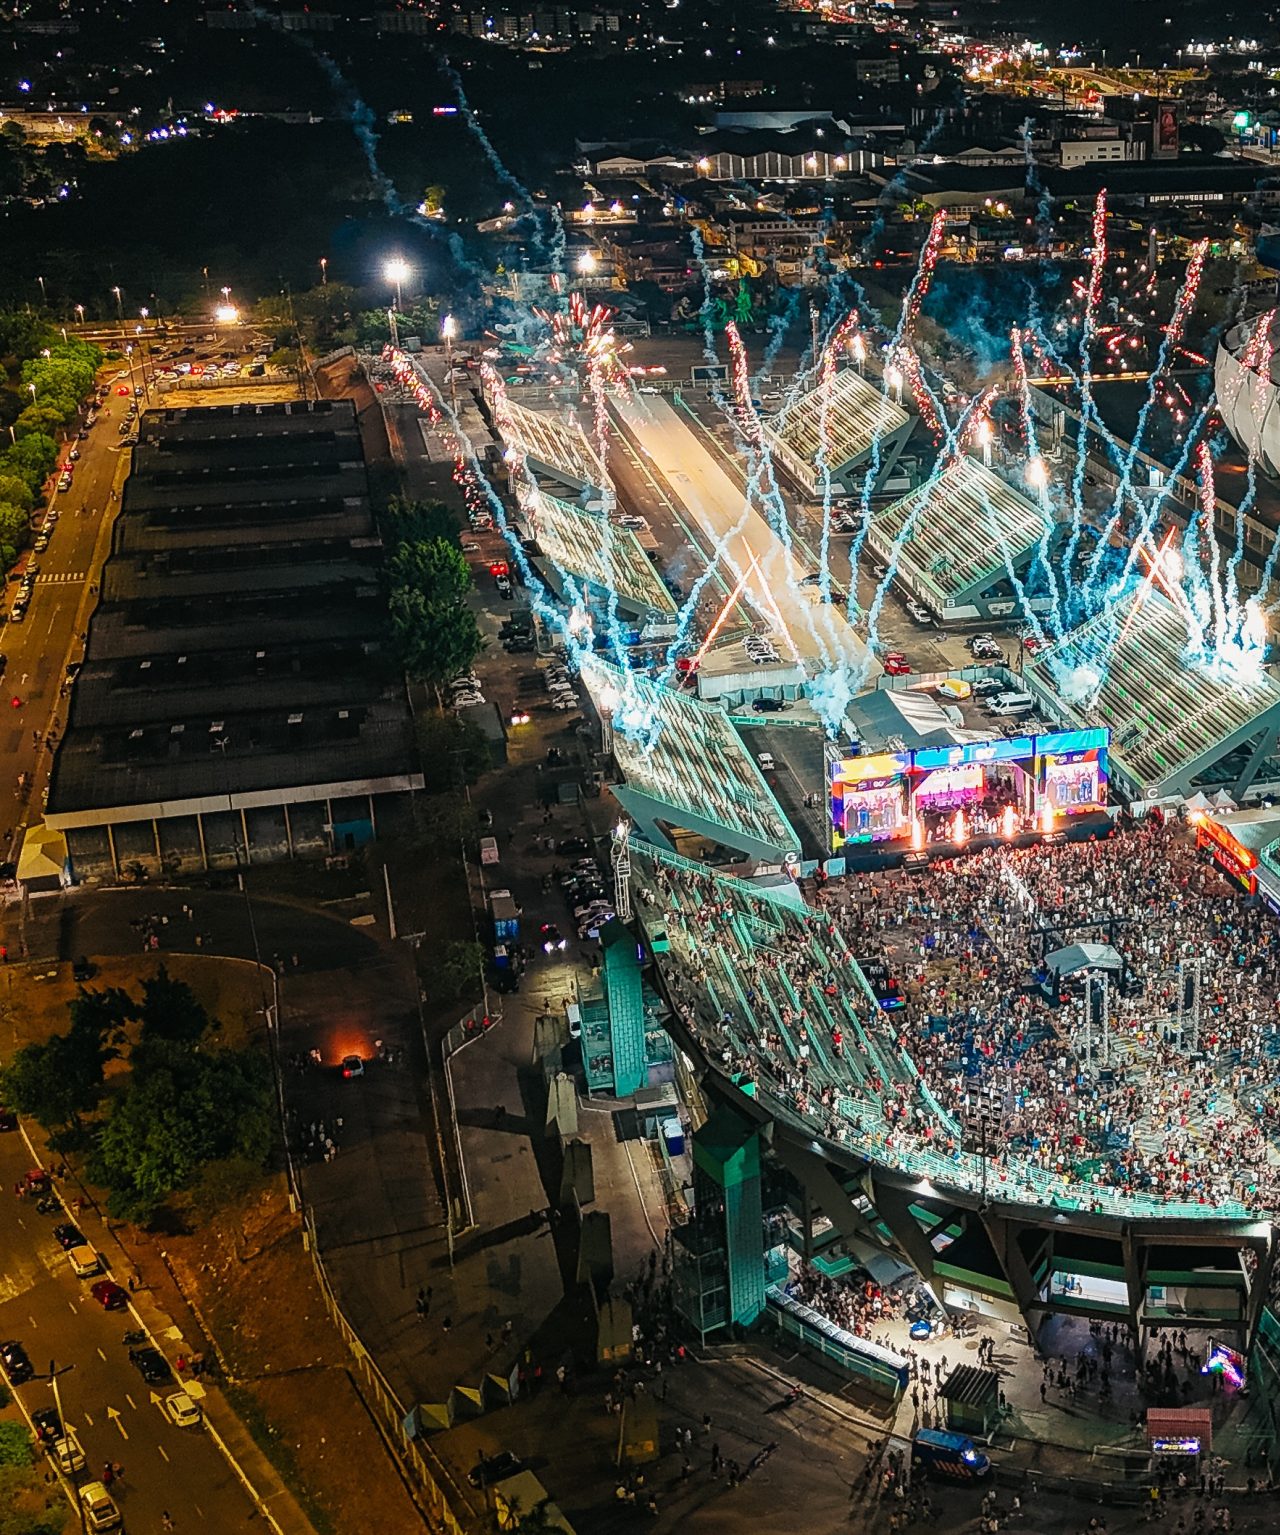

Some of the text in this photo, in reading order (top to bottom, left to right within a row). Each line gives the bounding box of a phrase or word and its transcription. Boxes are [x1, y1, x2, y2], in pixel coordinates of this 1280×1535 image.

[946, 599, 956, 607] B
[667, 615, 675, 623] F
[1147, 788, 1158, 798] C
[785, 852, 797, 863] G
